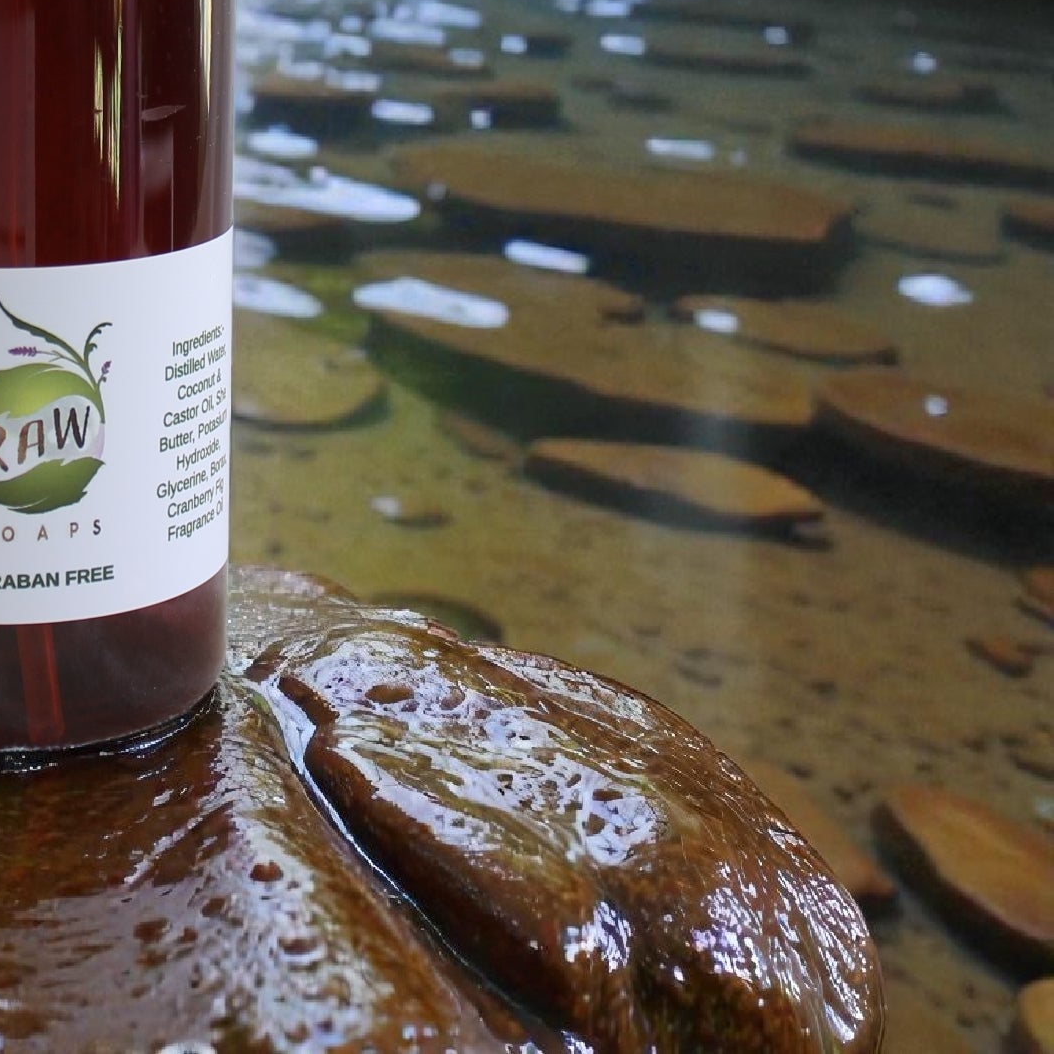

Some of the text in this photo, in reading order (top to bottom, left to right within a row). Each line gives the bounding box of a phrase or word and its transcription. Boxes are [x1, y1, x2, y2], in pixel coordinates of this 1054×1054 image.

[165, 352, 206, 382] Distilled
[177, 367, 222, 400] Coconut &
[163, 405, 200, 428] Castor
[159, 430, 195, 453] Butter,
[176, 437, 221, 471] Hydroxide,
[156, 469, 209, 499] Glycerine,
[167, 487, 215, 518] Cranberry
[168, 508, 215, 541] Fragrance
[65, 565, 114, 587] FREE
